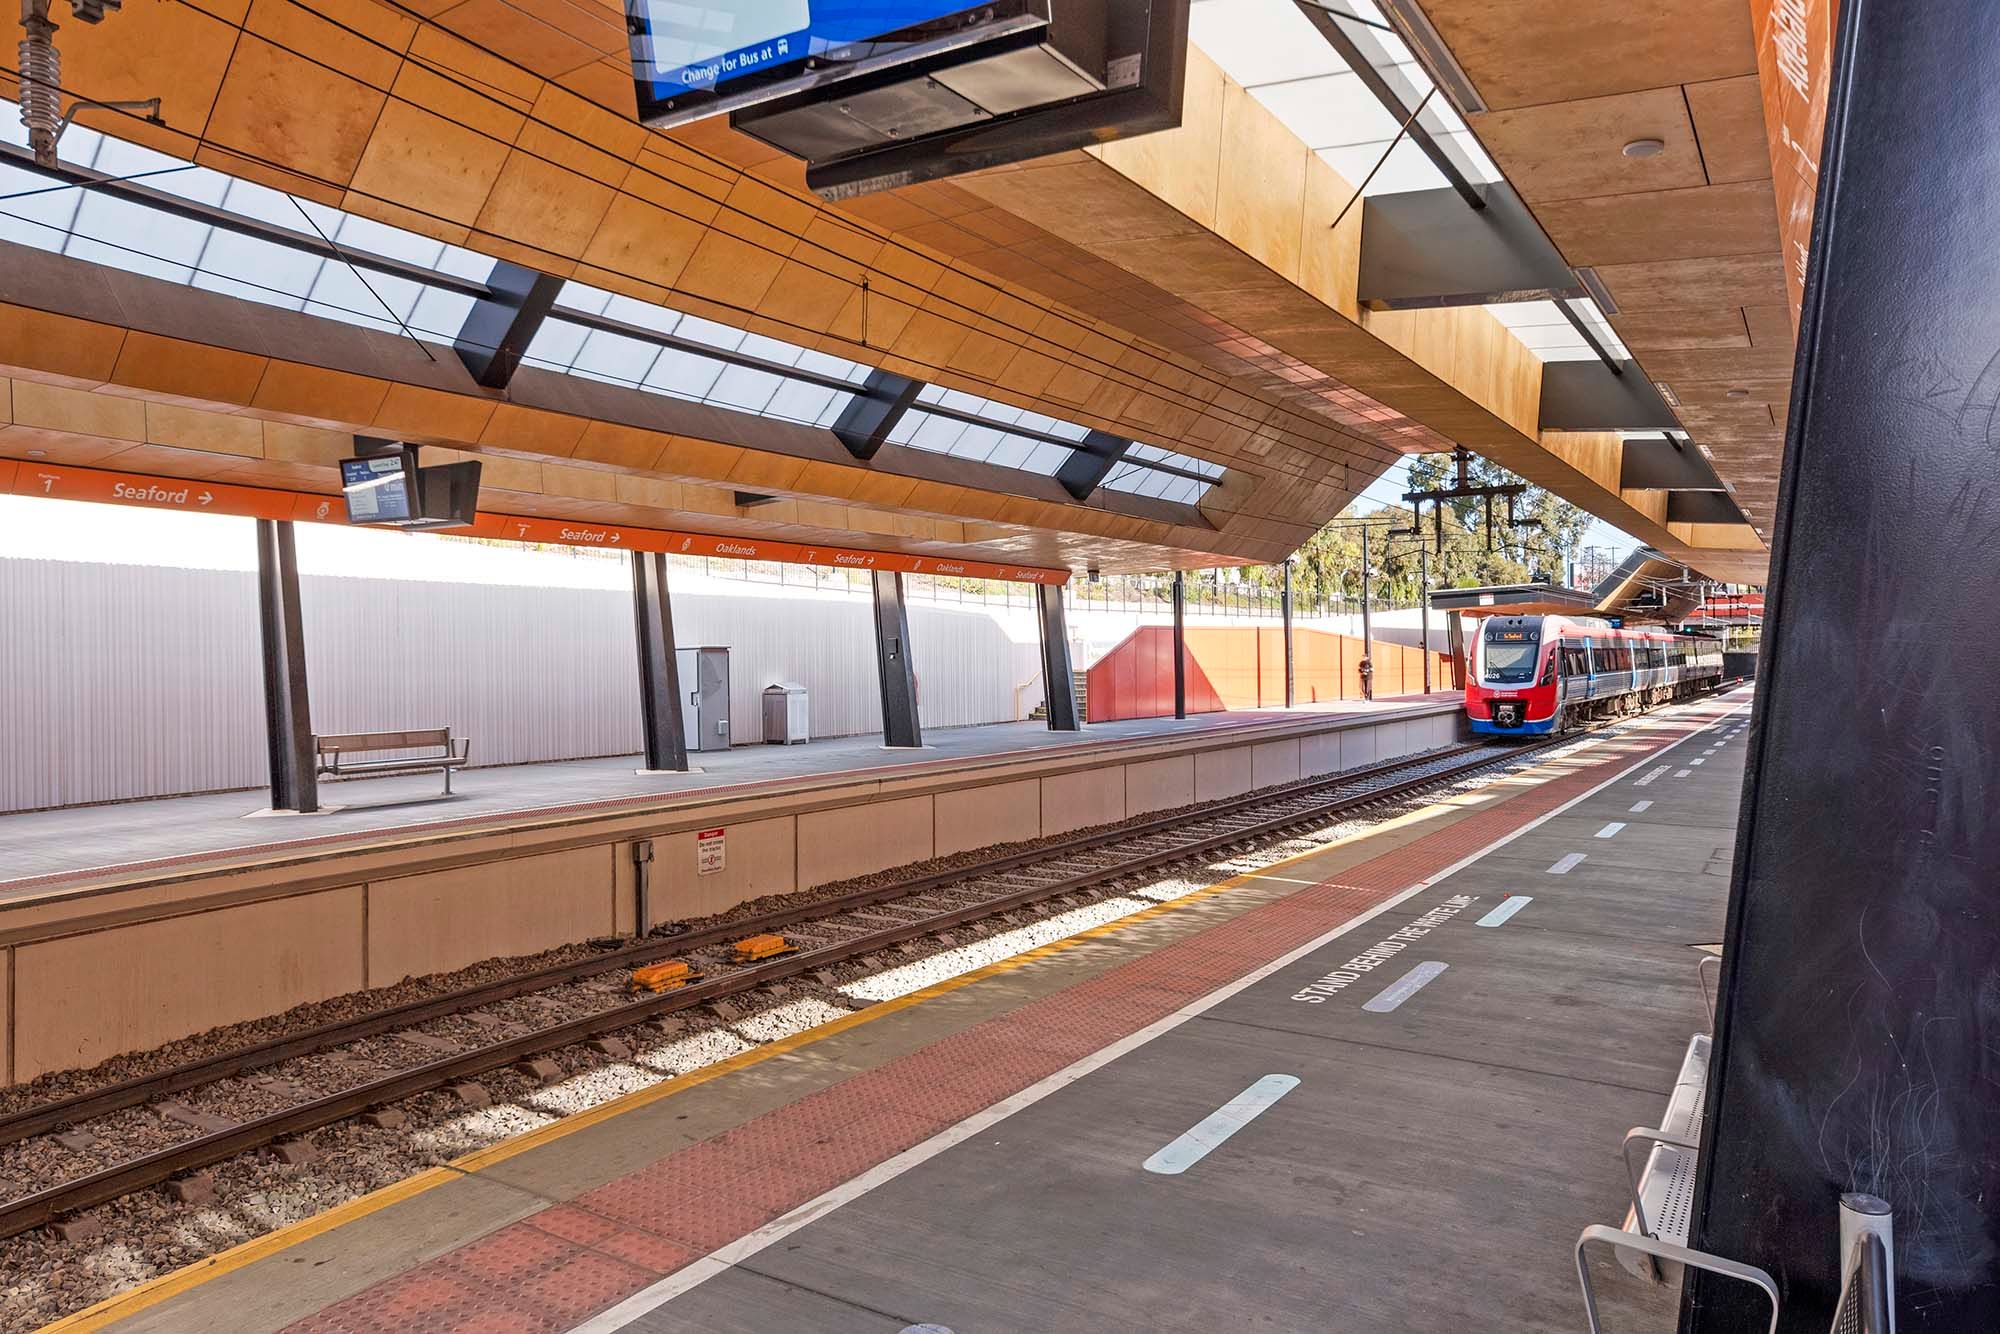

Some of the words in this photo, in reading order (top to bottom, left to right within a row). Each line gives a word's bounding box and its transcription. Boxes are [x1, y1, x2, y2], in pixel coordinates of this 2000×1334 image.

[682, 64, 720, 84] Change
[722, 57, 737, 72] for
[740, 52, 759, 67] Bus
[761, 46, 773, 61] at
[1791, 140, 1817, 173] 2
[43, 479, 52, 493] 1
[113, 482, 189, 504] Seaford
[560, 528, 606, 542] Seaford
[715, 543, 757, 556] Oaklands
[833, 553, 865, 565] Seaford
[1290, 971, 1361, 1004] STAND
[1340, 941, 1407, 972] BEHIND
[1387, 926, 1431, 941] THE
[1409, 907, 1460, 928] WHITE
